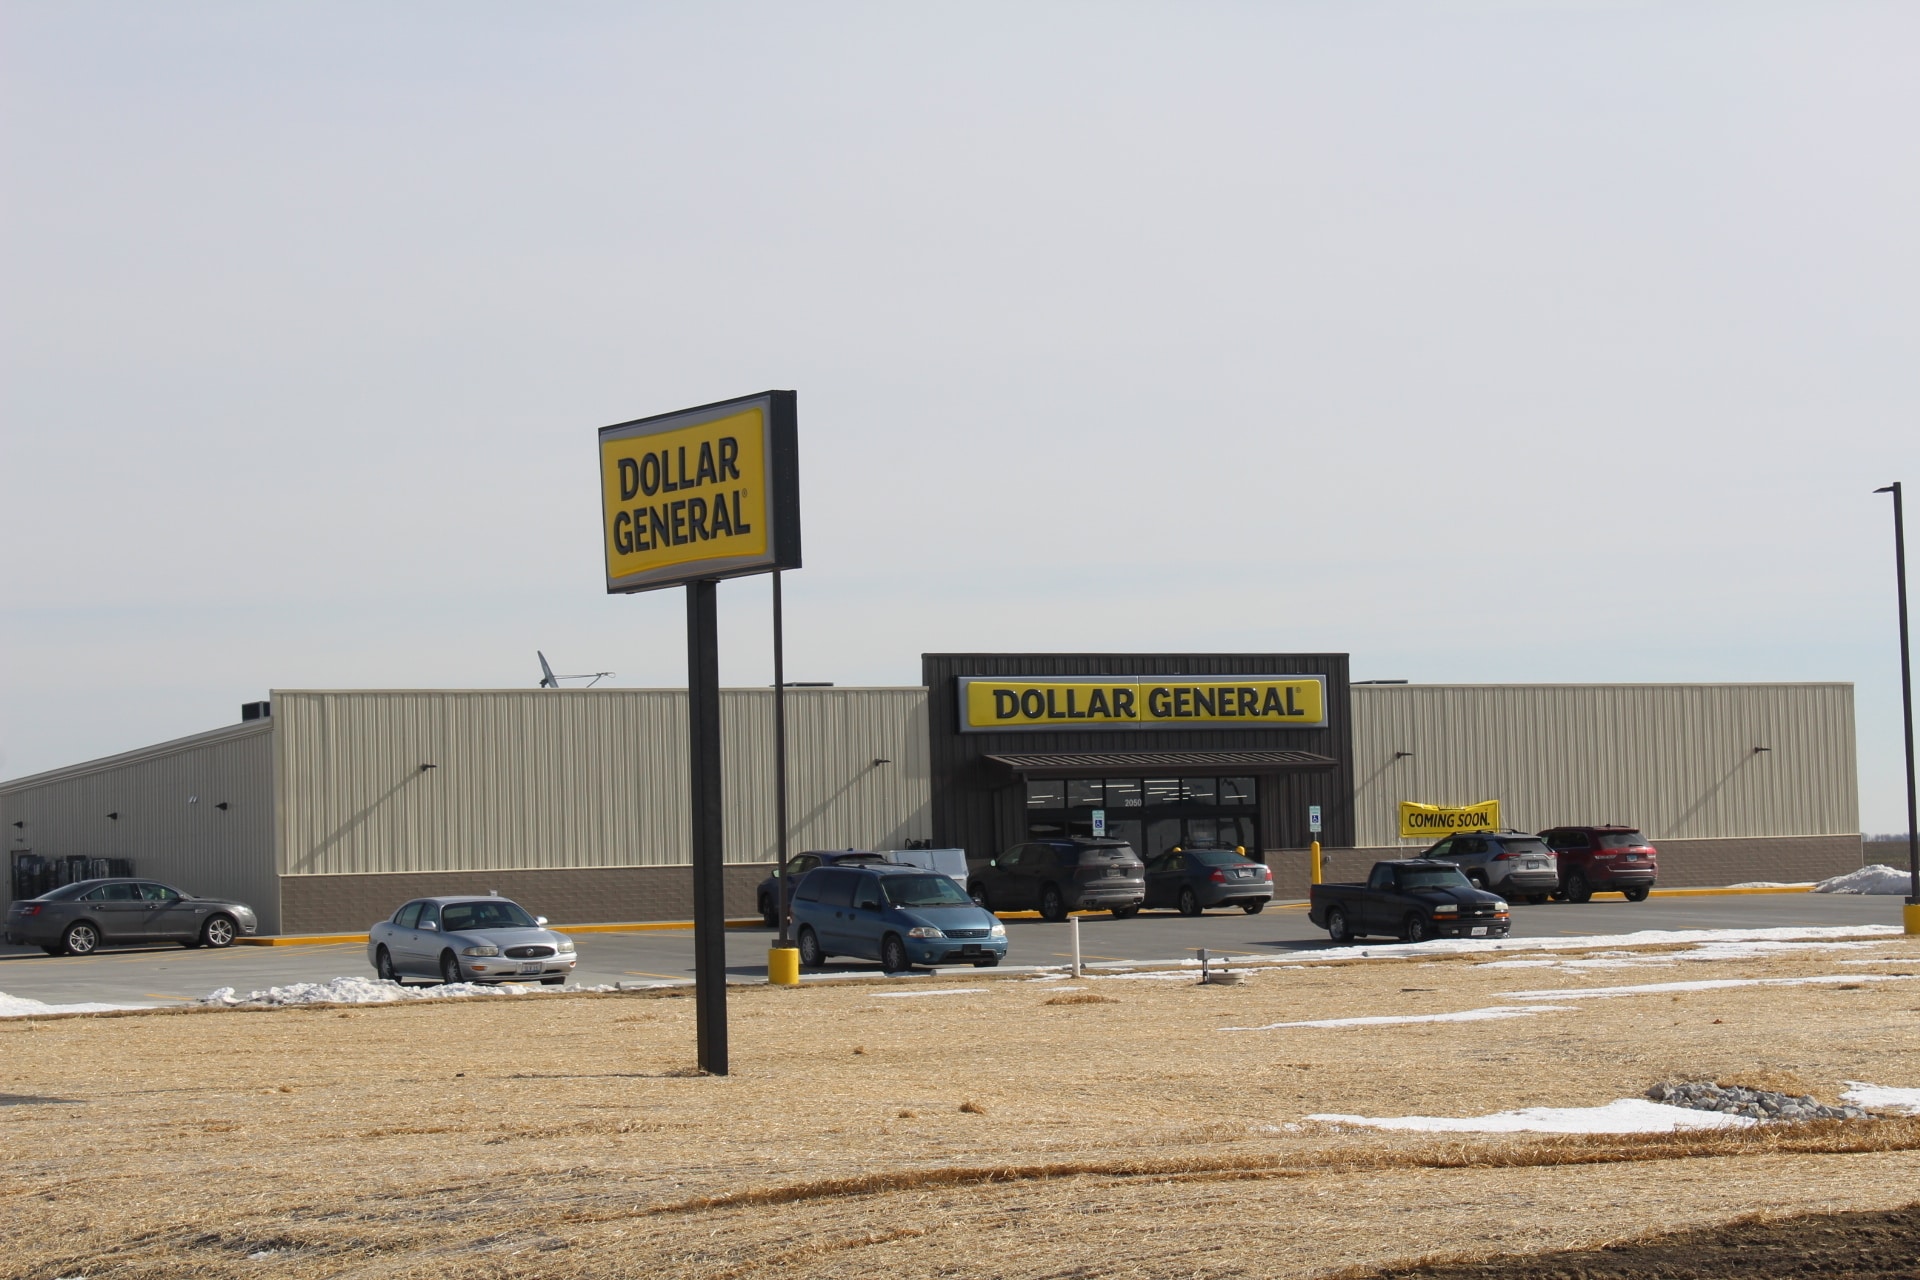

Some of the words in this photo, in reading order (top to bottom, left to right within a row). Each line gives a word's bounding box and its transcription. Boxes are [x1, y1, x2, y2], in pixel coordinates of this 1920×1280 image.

[617, 436, 740, 501] DOLLAR
[613, 490, 751, 555] GENERAL
[993, 688, 1137, 719] DOLLAR
[1148, 686, 1305, 718] GENERAL
[1124, 799, 1142, 807] 2050
[1408, 813, 1455, 828] COMING
